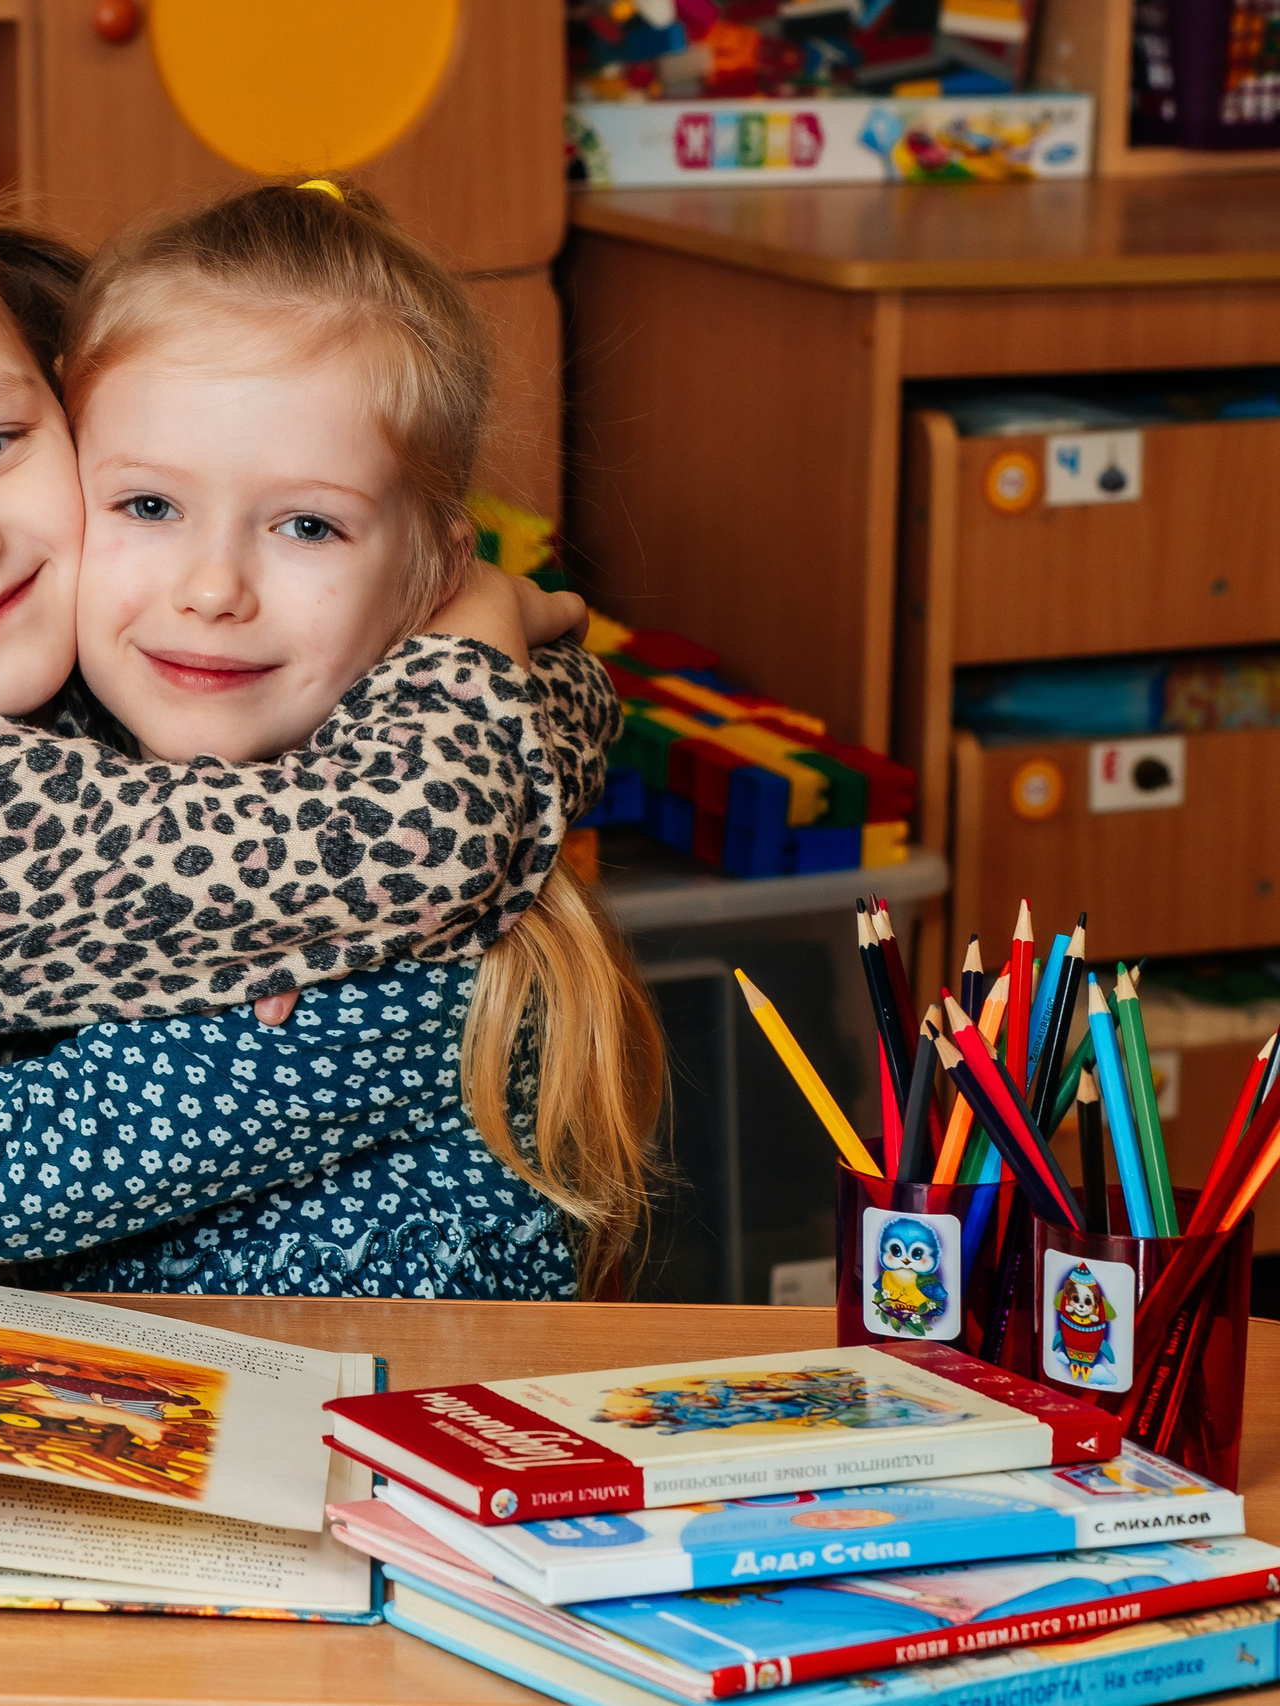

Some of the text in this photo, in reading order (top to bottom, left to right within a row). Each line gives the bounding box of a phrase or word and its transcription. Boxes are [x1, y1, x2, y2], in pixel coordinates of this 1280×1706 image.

[652, 1469, 768, 1493] ПРИКЛЮЧЕНИЯ
[774, 1464, 827, 1481] НОВЫЕ
[531, 1484, 630, 1507] МАЙКЛ БОНД
[731, 1539, 912, 1578] Дядя Стёпа
[895, 1602, 1142, 1664] КОННИ ЗАНИМАЕТСЯ ТАНЦАМИ
[1103, 1671, 1125, 1691] На
[1131, 1658, 1205, 1686] стройке
